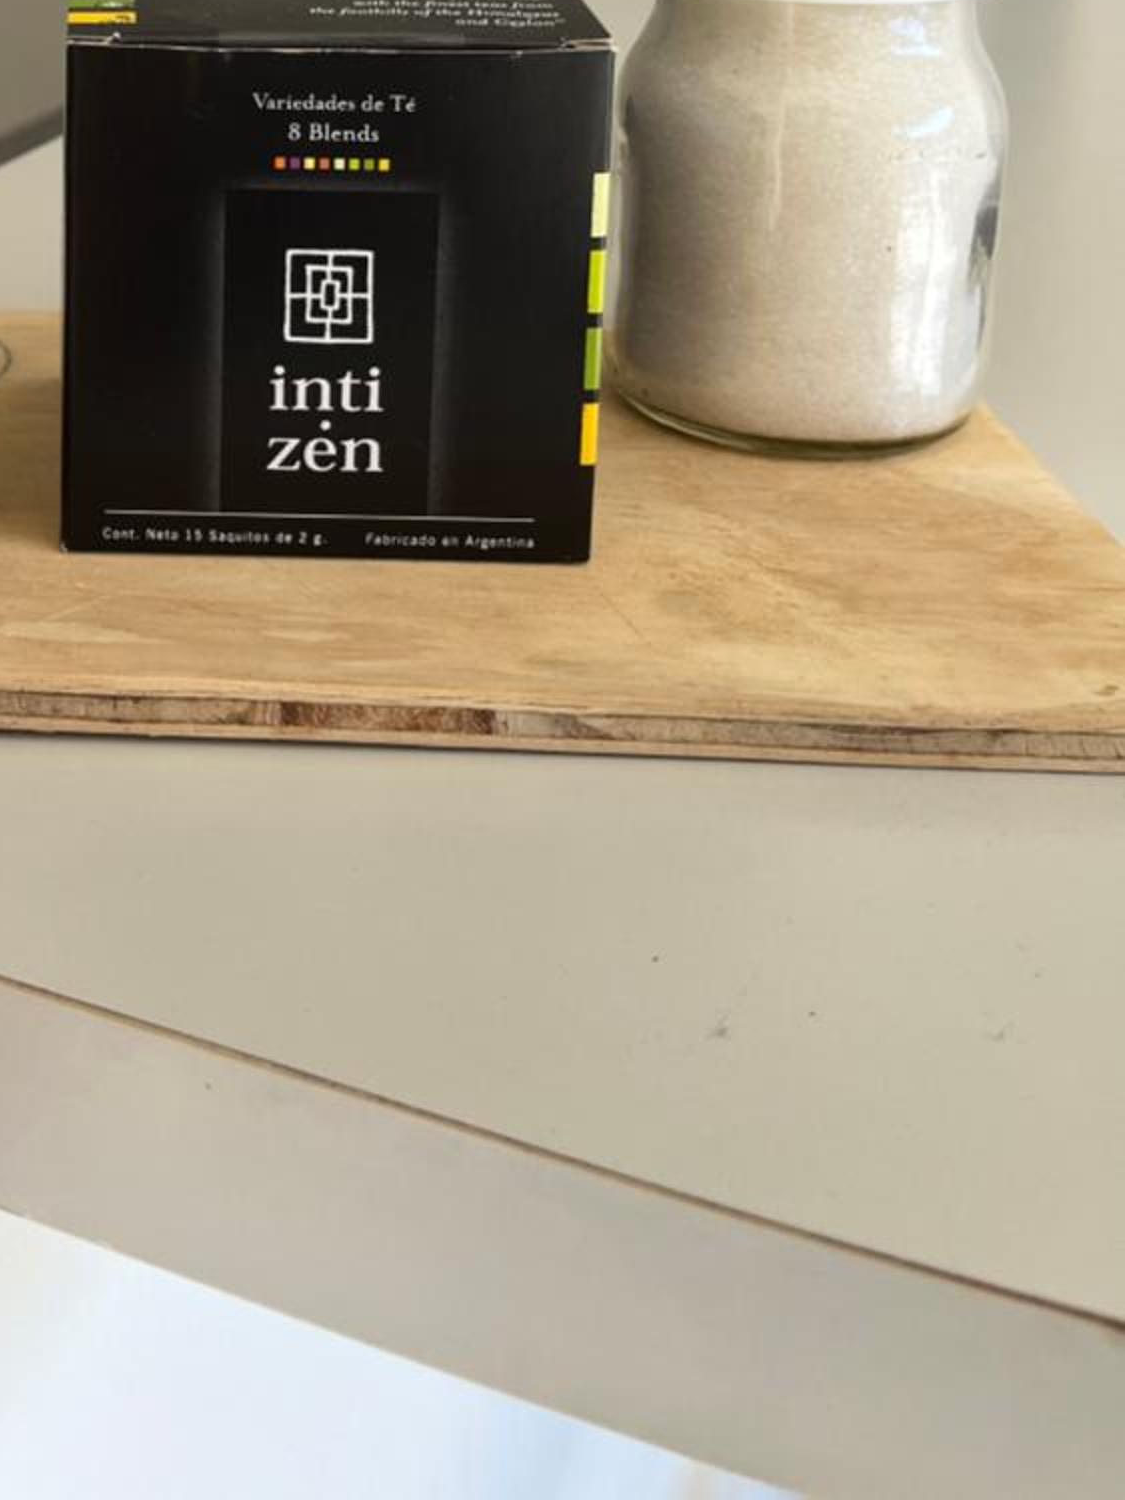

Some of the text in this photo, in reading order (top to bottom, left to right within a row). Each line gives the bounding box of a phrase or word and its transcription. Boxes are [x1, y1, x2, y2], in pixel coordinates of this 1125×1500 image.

[252, 92, 417, 113] Variedades de Té
[287, 122, 380, 143] 8 Blends
[269, 365, 385, 412] inti
[102, 526, 140, 542] Cont.
[144, 527, 180, 542] Neto
[275, 531, 294, 545] de
[298, 531, 309, 546] 2
[365, 531, 536, 551] Fabricado en Argentina
